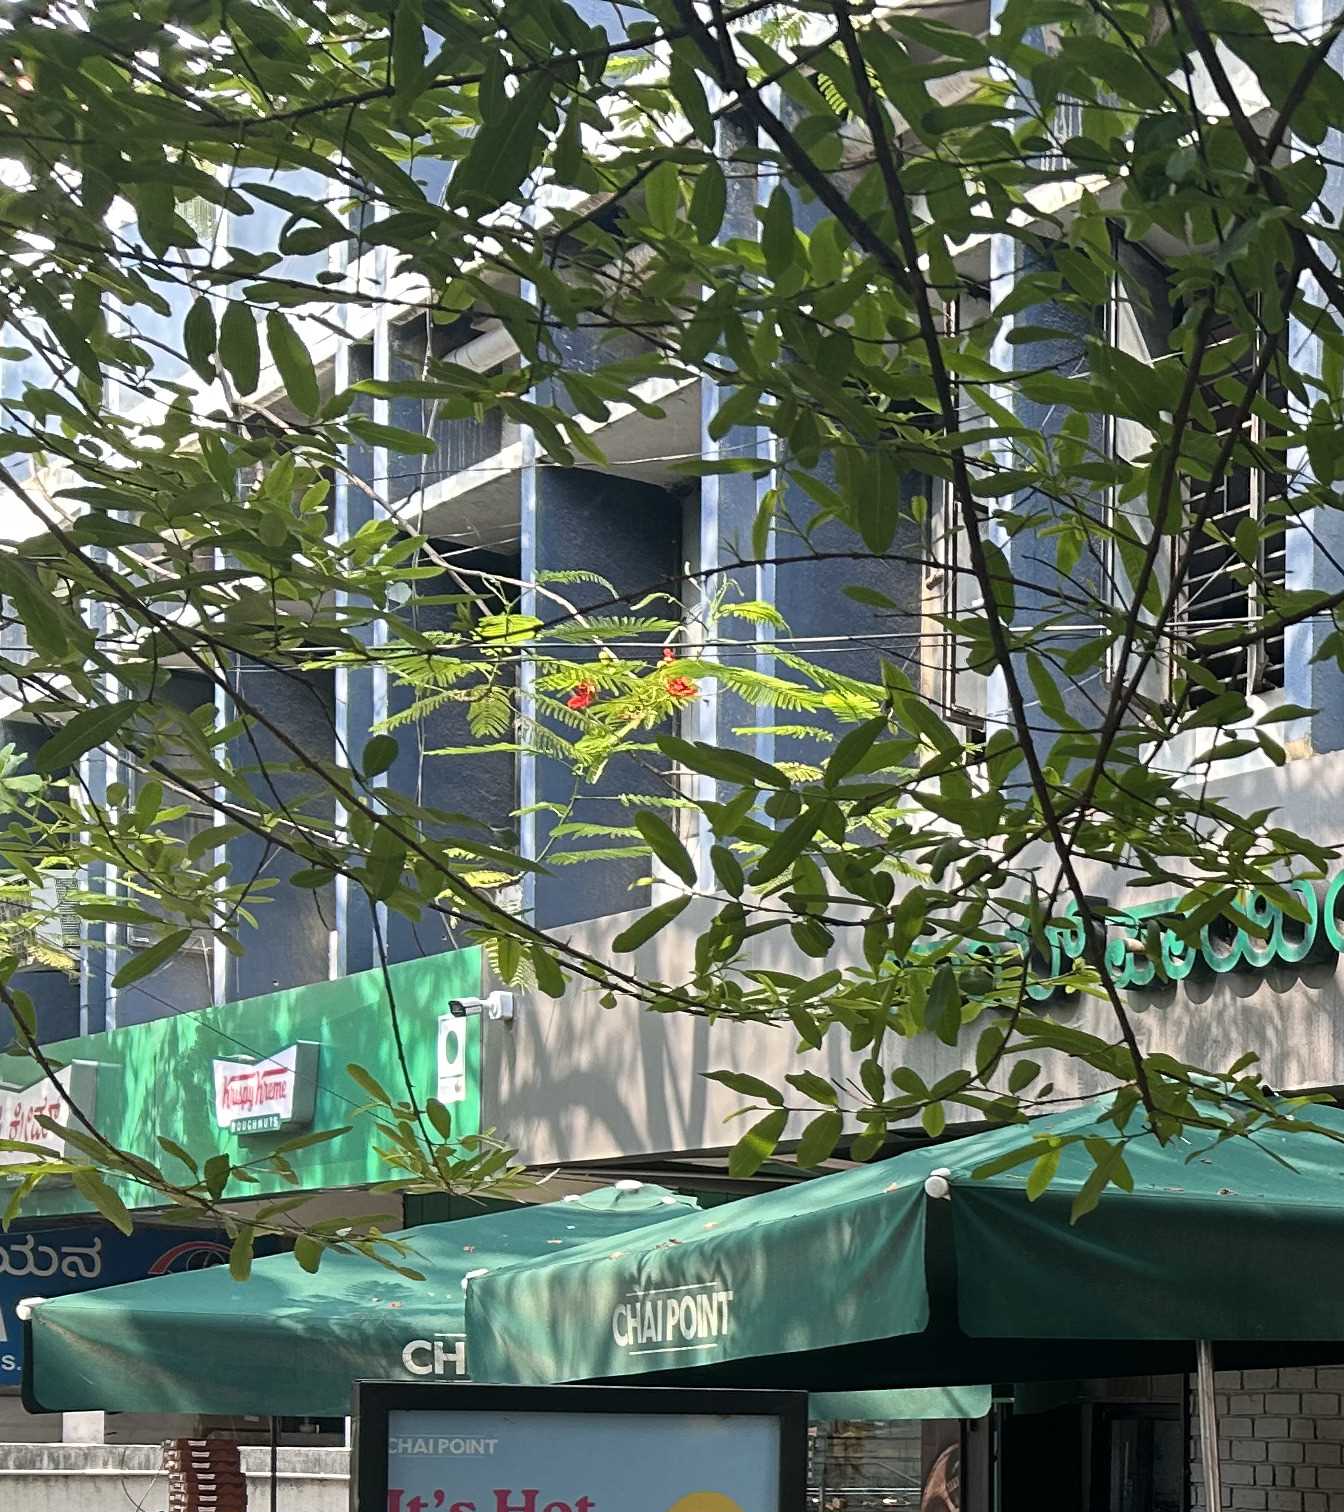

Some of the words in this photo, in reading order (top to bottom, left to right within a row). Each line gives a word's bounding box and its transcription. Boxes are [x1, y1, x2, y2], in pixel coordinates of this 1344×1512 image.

[222, 1074, 254, 1113] Krispy
[255, 1067, 289, 1105] Kreme
[612, 1300, 663, 1348] CHAI
[667, 1290, 734, 1342] POINT
[387, 1438, 433, 1455] CHAI
[438, 1438, 499, 1455] POINT
